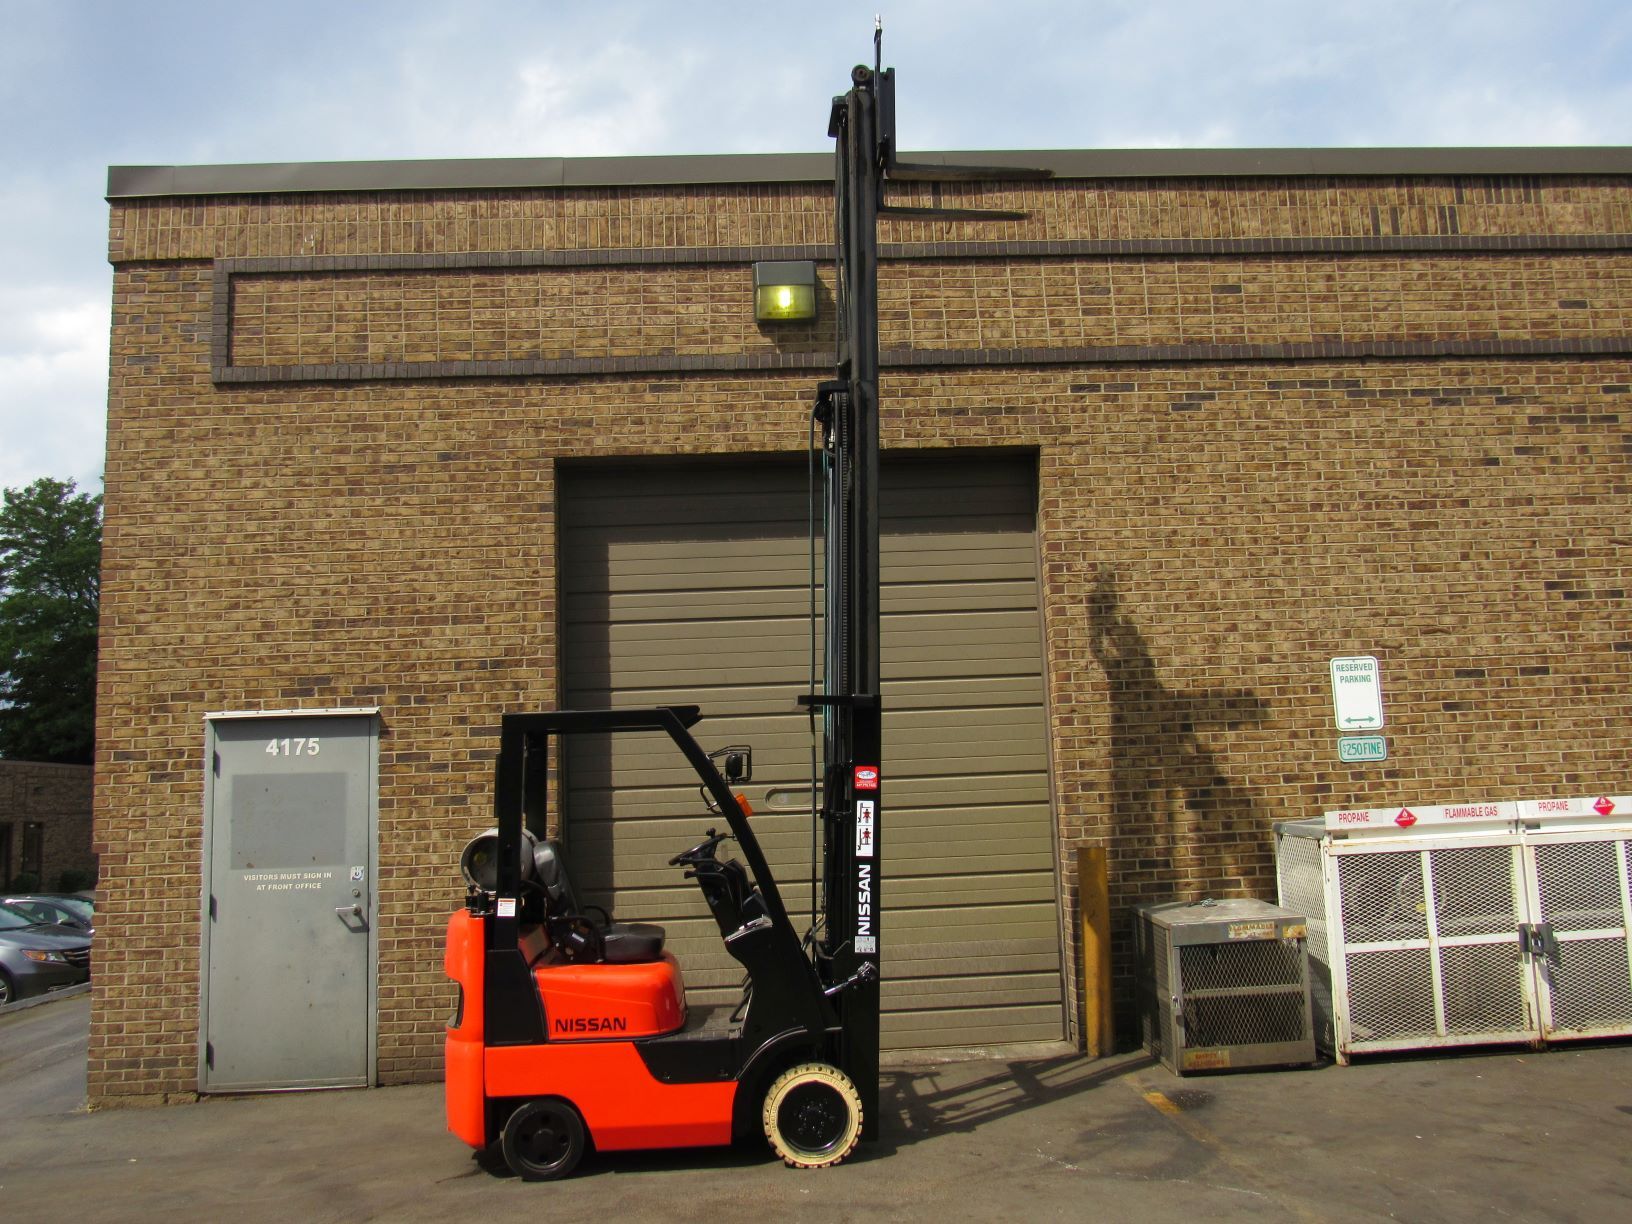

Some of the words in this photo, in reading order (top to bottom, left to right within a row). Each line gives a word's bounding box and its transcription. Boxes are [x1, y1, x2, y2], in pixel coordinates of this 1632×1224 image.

[1335, 663, 1373, 672] RESERVED
[1340, 674, 1371, 683] PARKING
[265, 737, 320, 756] 4175
[1363, 742, 1382, 755] FINE
[1445, 807, 1483, 818] FLAMMABLE
[1484, 806, 1498, 817] GAS
[1537, 800, 1569, 812] PROPANE
[1338, 811, 1370, 823] PROPANE
[243, 873, 278, 881] VISITORS
[323, 871, 332, 879] IN
[858, 864, 871, 935] NISSAN
[555, 1017, 627, 1032] NISSAN
